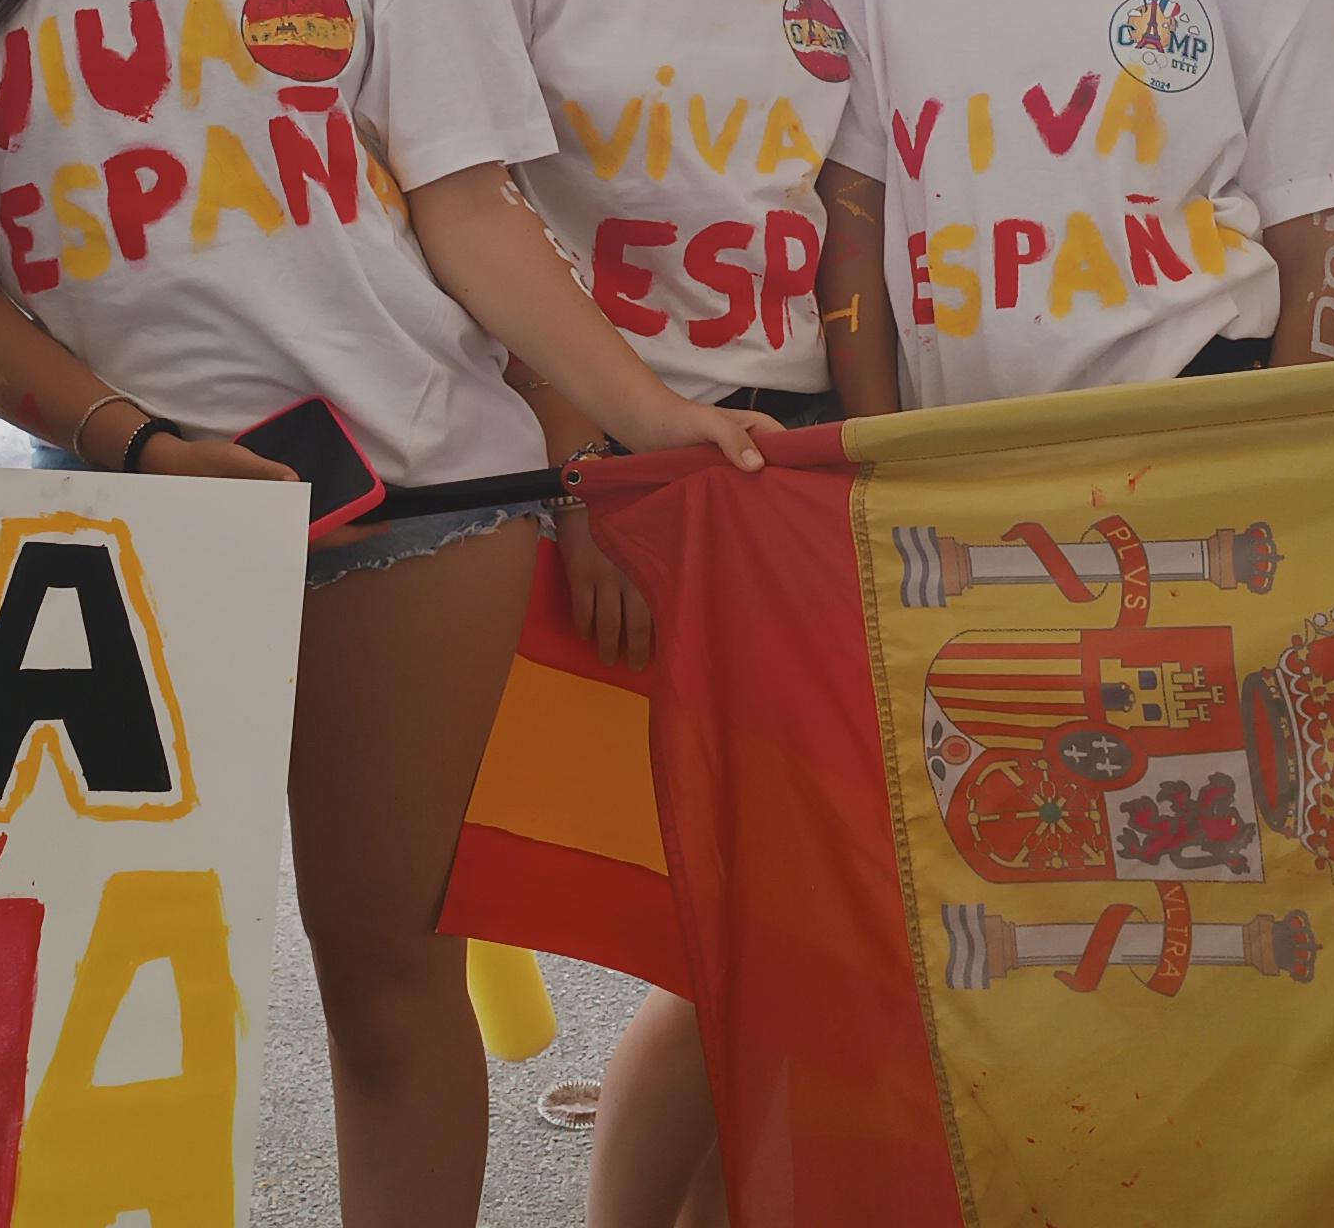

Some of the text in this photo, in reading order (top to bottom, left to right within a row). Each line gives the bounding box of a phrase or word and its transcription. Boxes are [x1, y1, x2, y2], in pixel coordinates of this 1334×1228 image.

[1117, 12, 1207, 62] CAMP
[892, 66, 1169, 181] VIVA
[1150, 77, 1171, 89] 2024
[1106, 525, 1150, 613] PLVS
[1158, 884, 1190, 979] VLTRA
